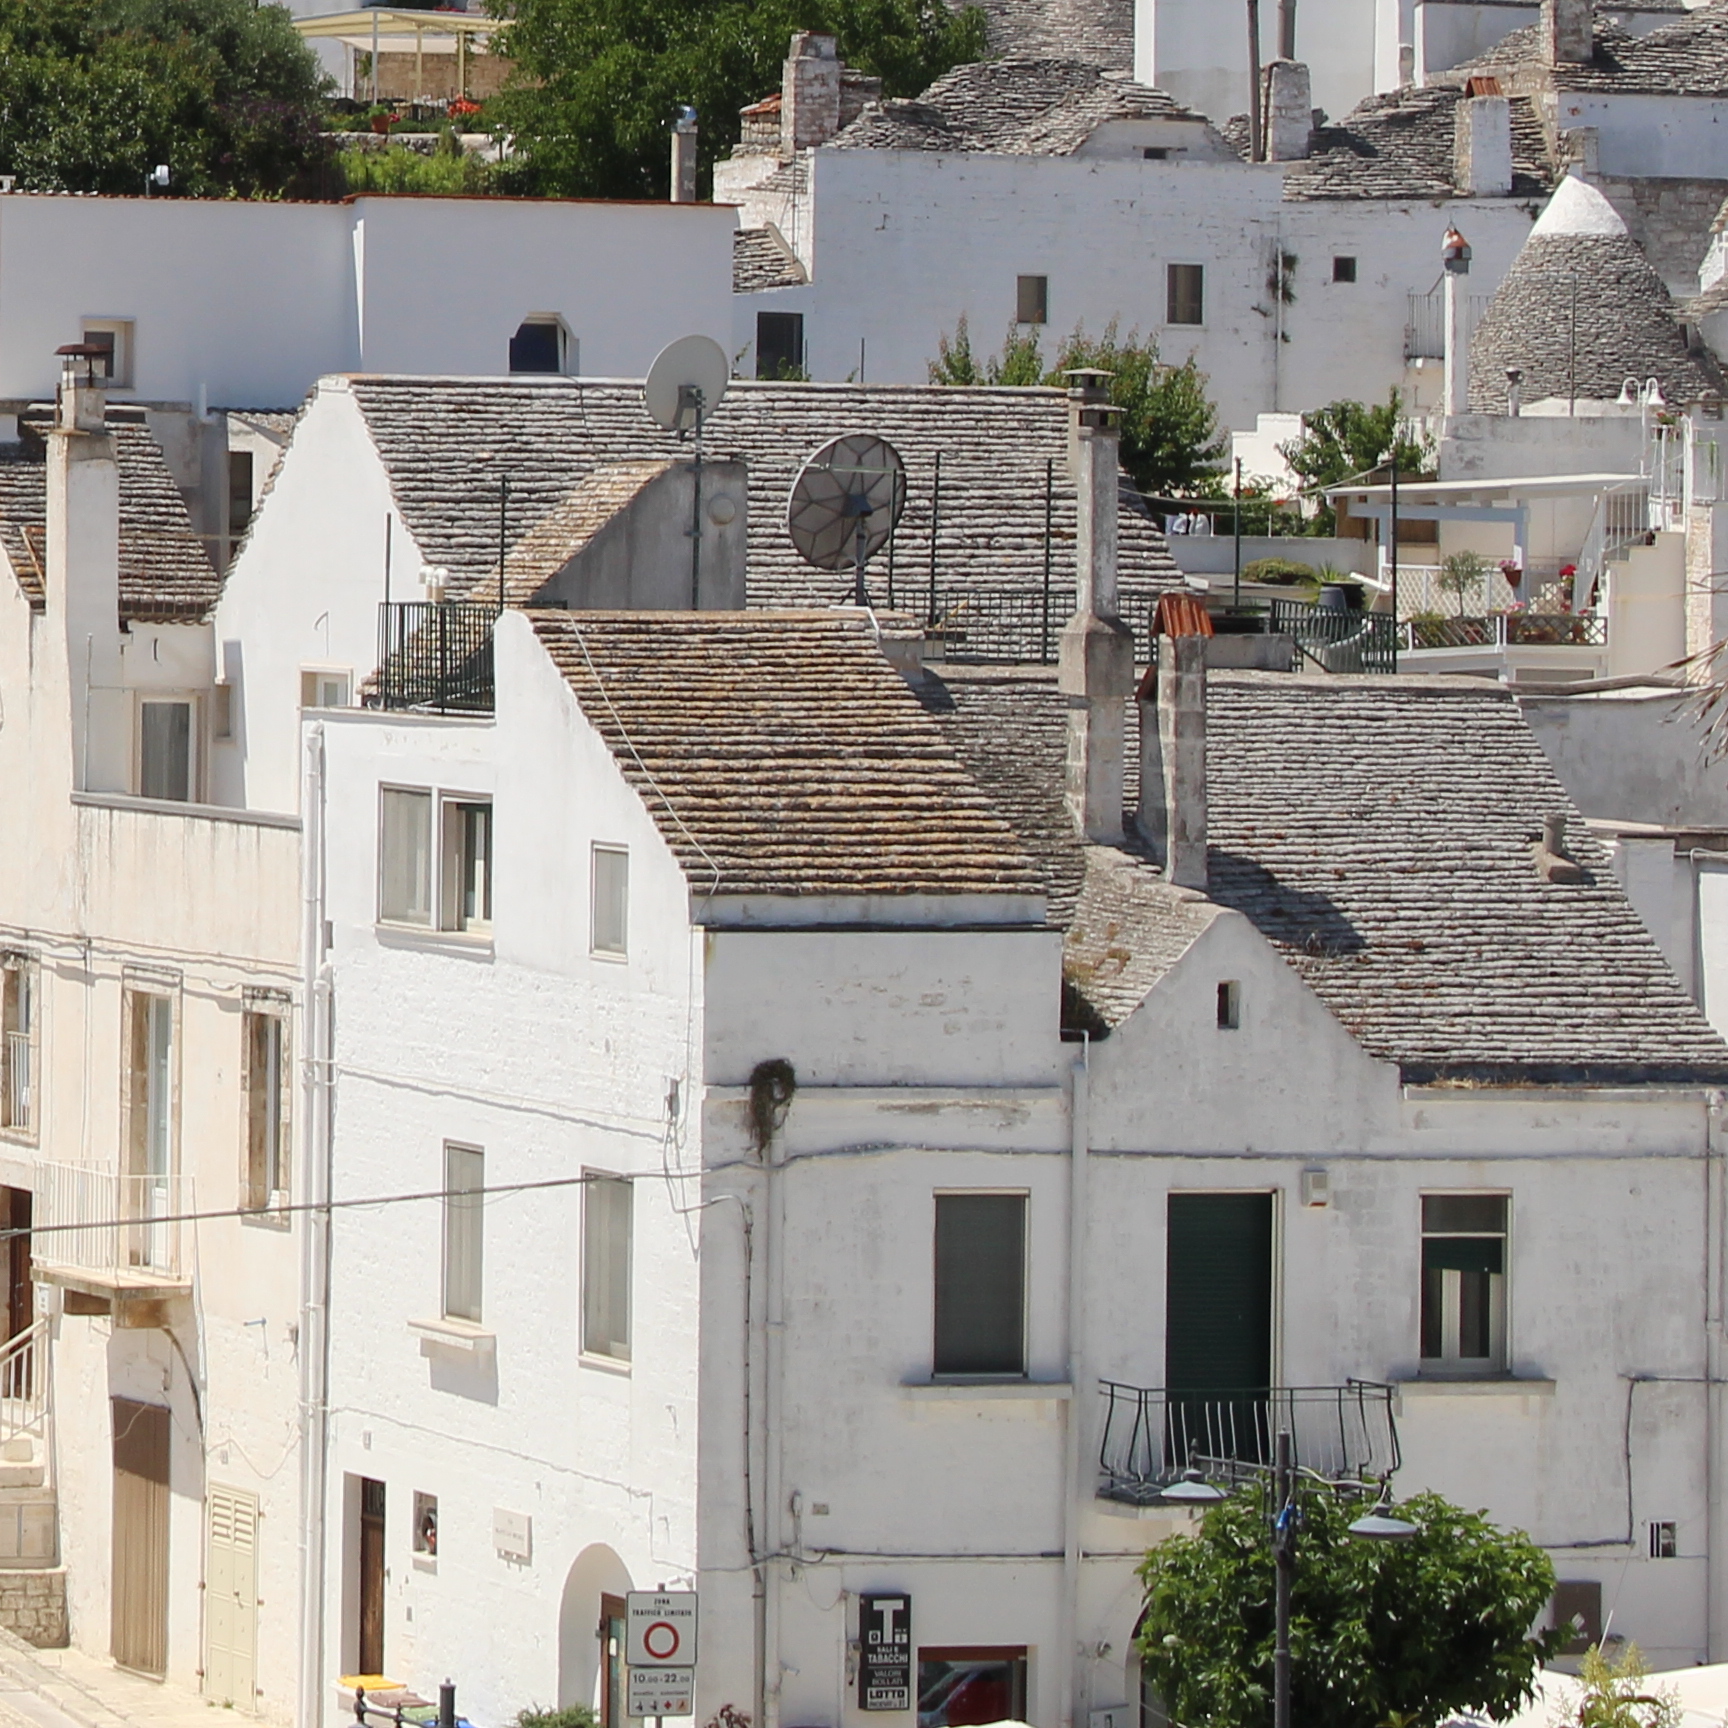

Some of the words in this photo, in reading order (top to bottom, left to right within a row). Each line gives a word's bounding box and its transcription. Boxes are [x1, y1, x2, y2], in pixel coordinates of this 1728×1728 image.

[632, 1608, 661, 1616] TRAFFICO
[664, 1608, 692, 1616] LIMITATO
[873, 1599, 904, 1644] T
[868, 1654, 908, 1664] TABACCHI
[874, 1669, 901, 1677] VALORI
[872, 1678, 903, 1686] BOLLATI
[869, 1689, 905, 1699] LOTTO
